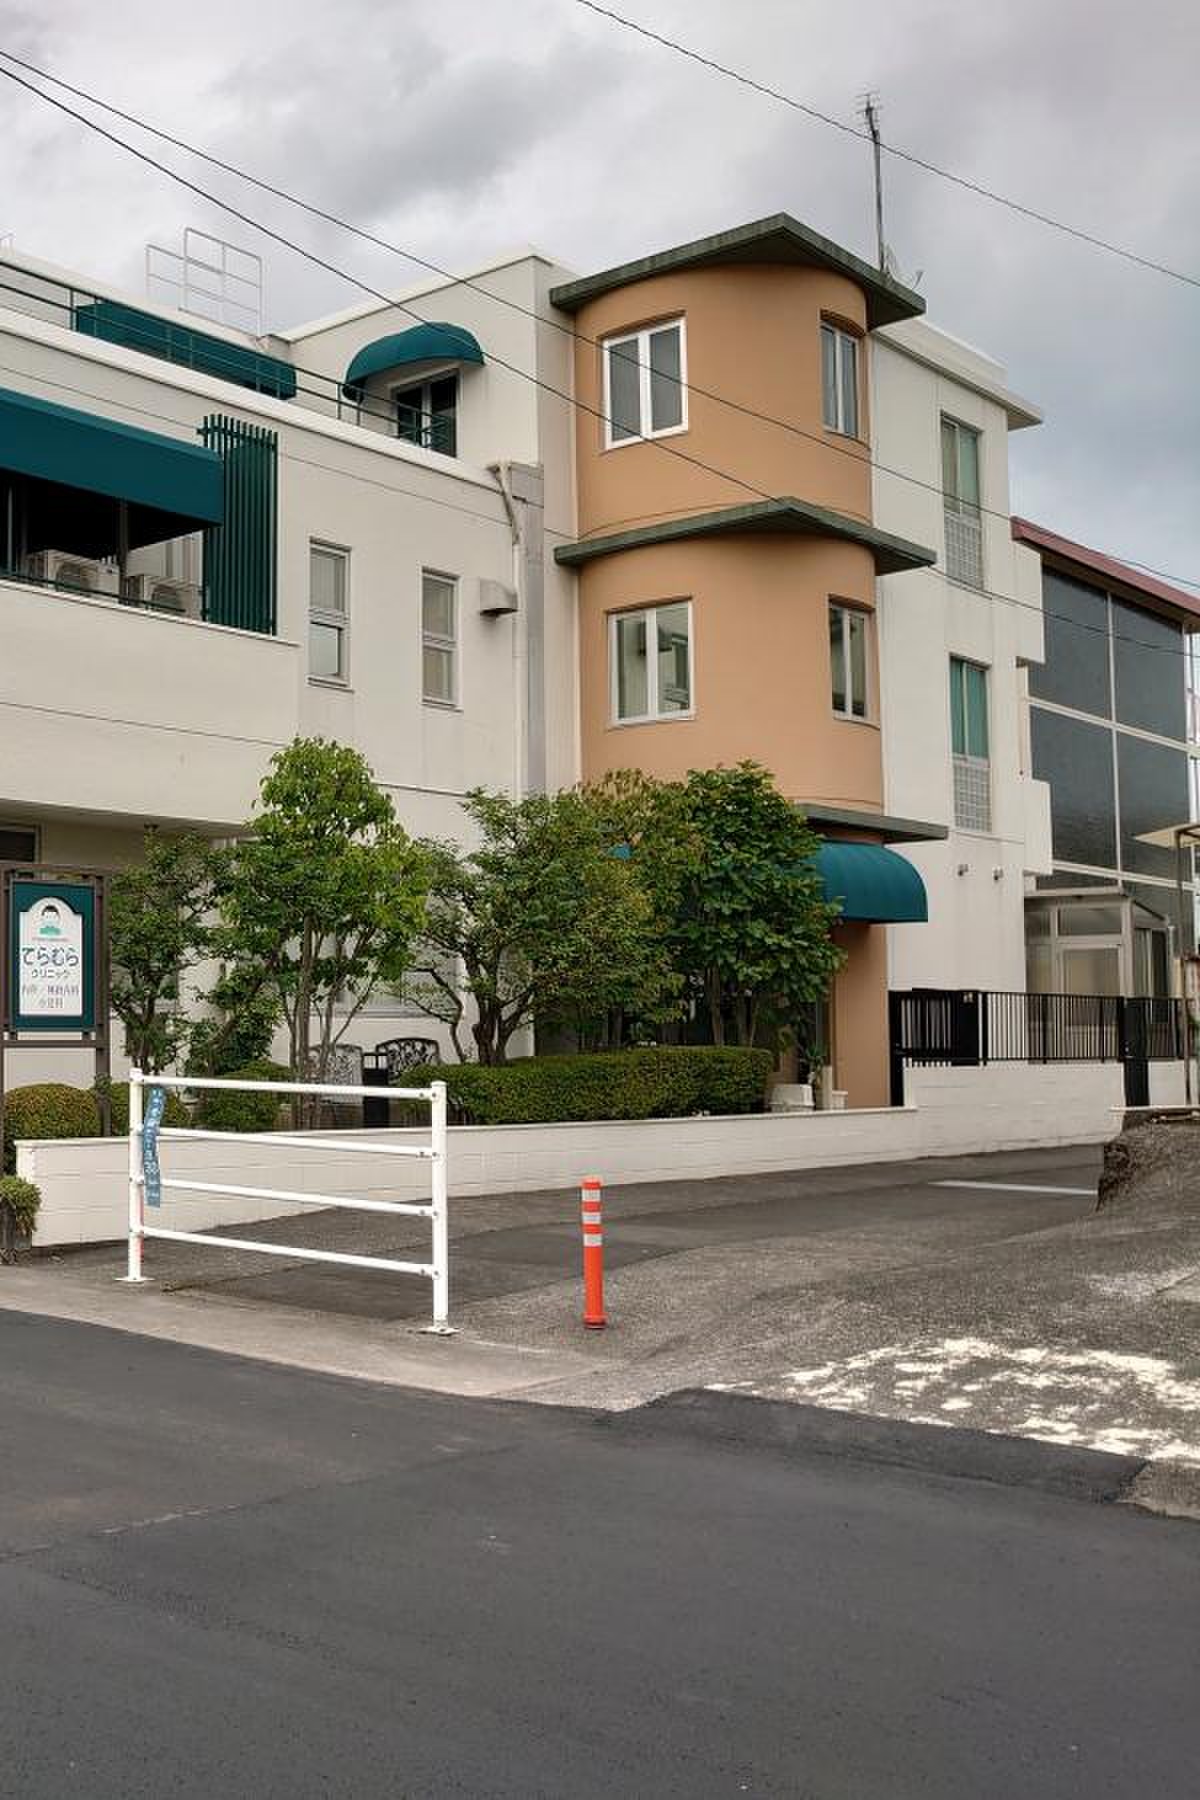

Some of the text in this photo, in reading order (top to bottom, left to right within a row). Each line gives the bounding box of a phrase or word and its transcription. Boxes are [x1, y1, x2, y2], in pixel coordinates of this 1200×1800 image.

[21, 946, 79, 967] てらむら
[31, 969, 69, 979] クリニック
